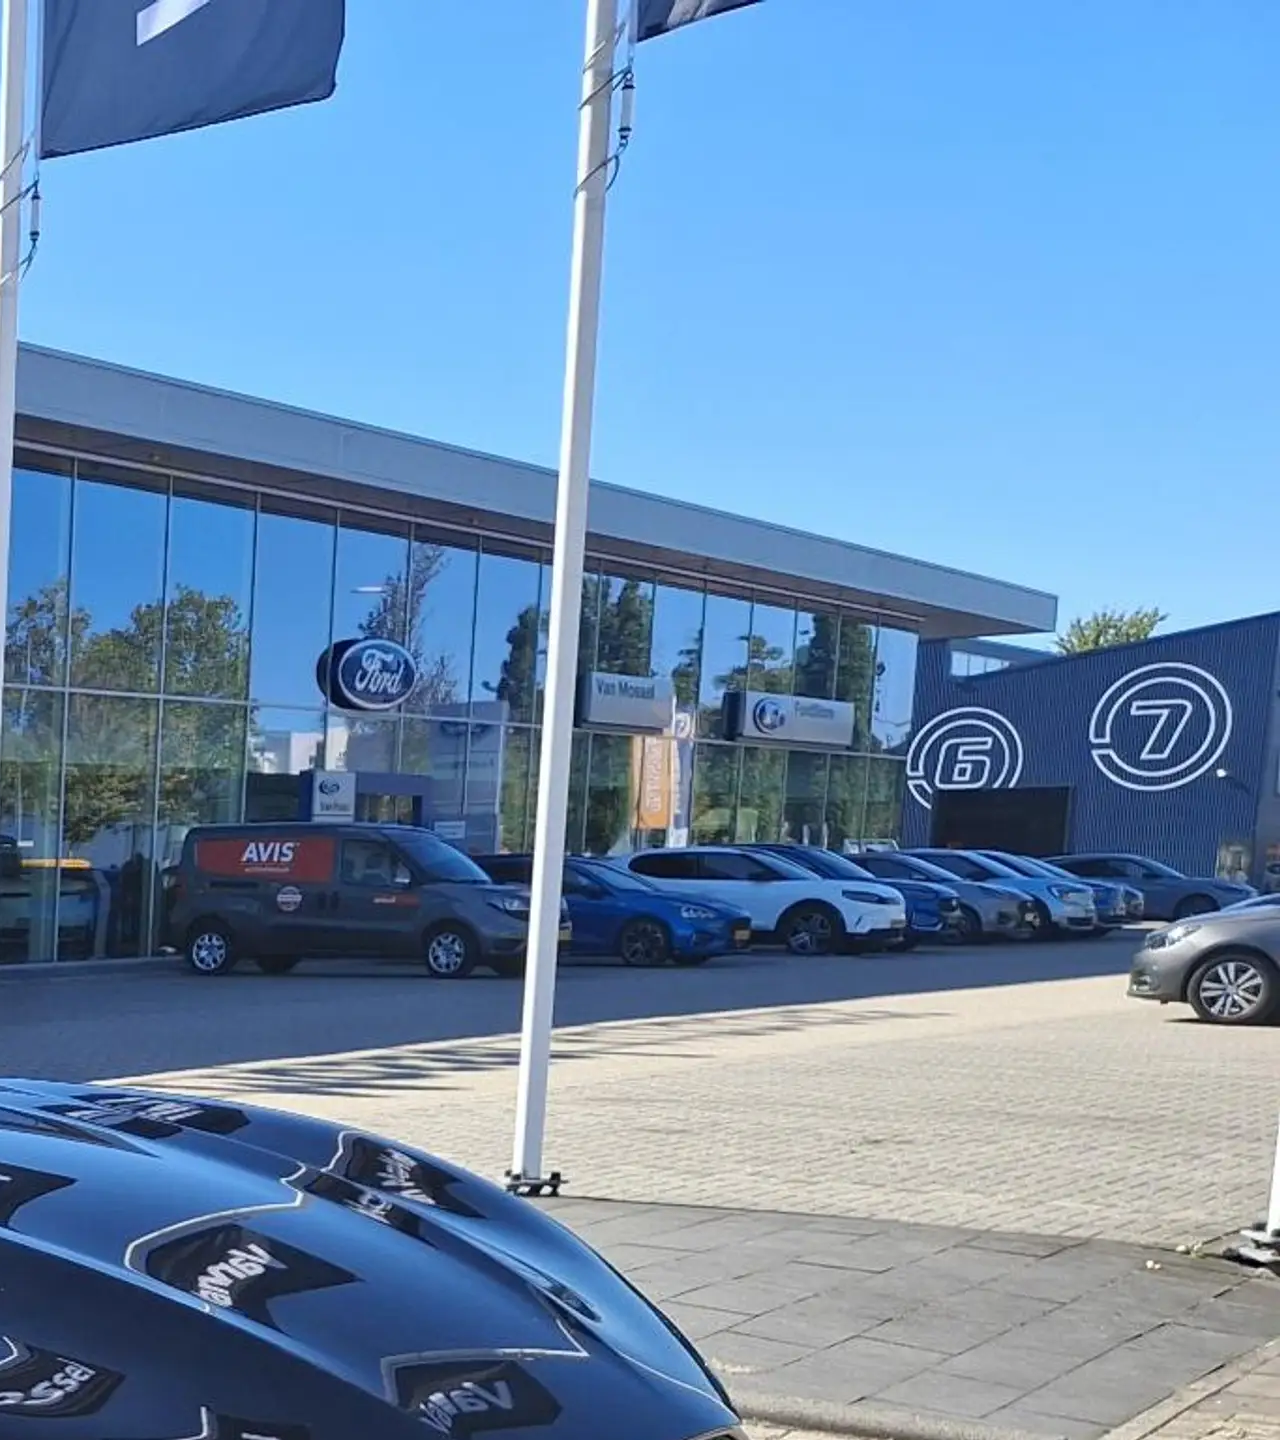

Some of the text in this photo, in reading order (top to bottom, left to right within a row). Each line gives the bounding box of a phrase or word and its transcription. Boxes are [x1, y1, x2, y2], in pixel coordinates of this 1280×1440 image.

[355, 648, 405, 694] Ford
[1130, 700, 1192, 760] 7
[935, 737, 991, 789] 6
[241, 841, 296, 863] AVIS
